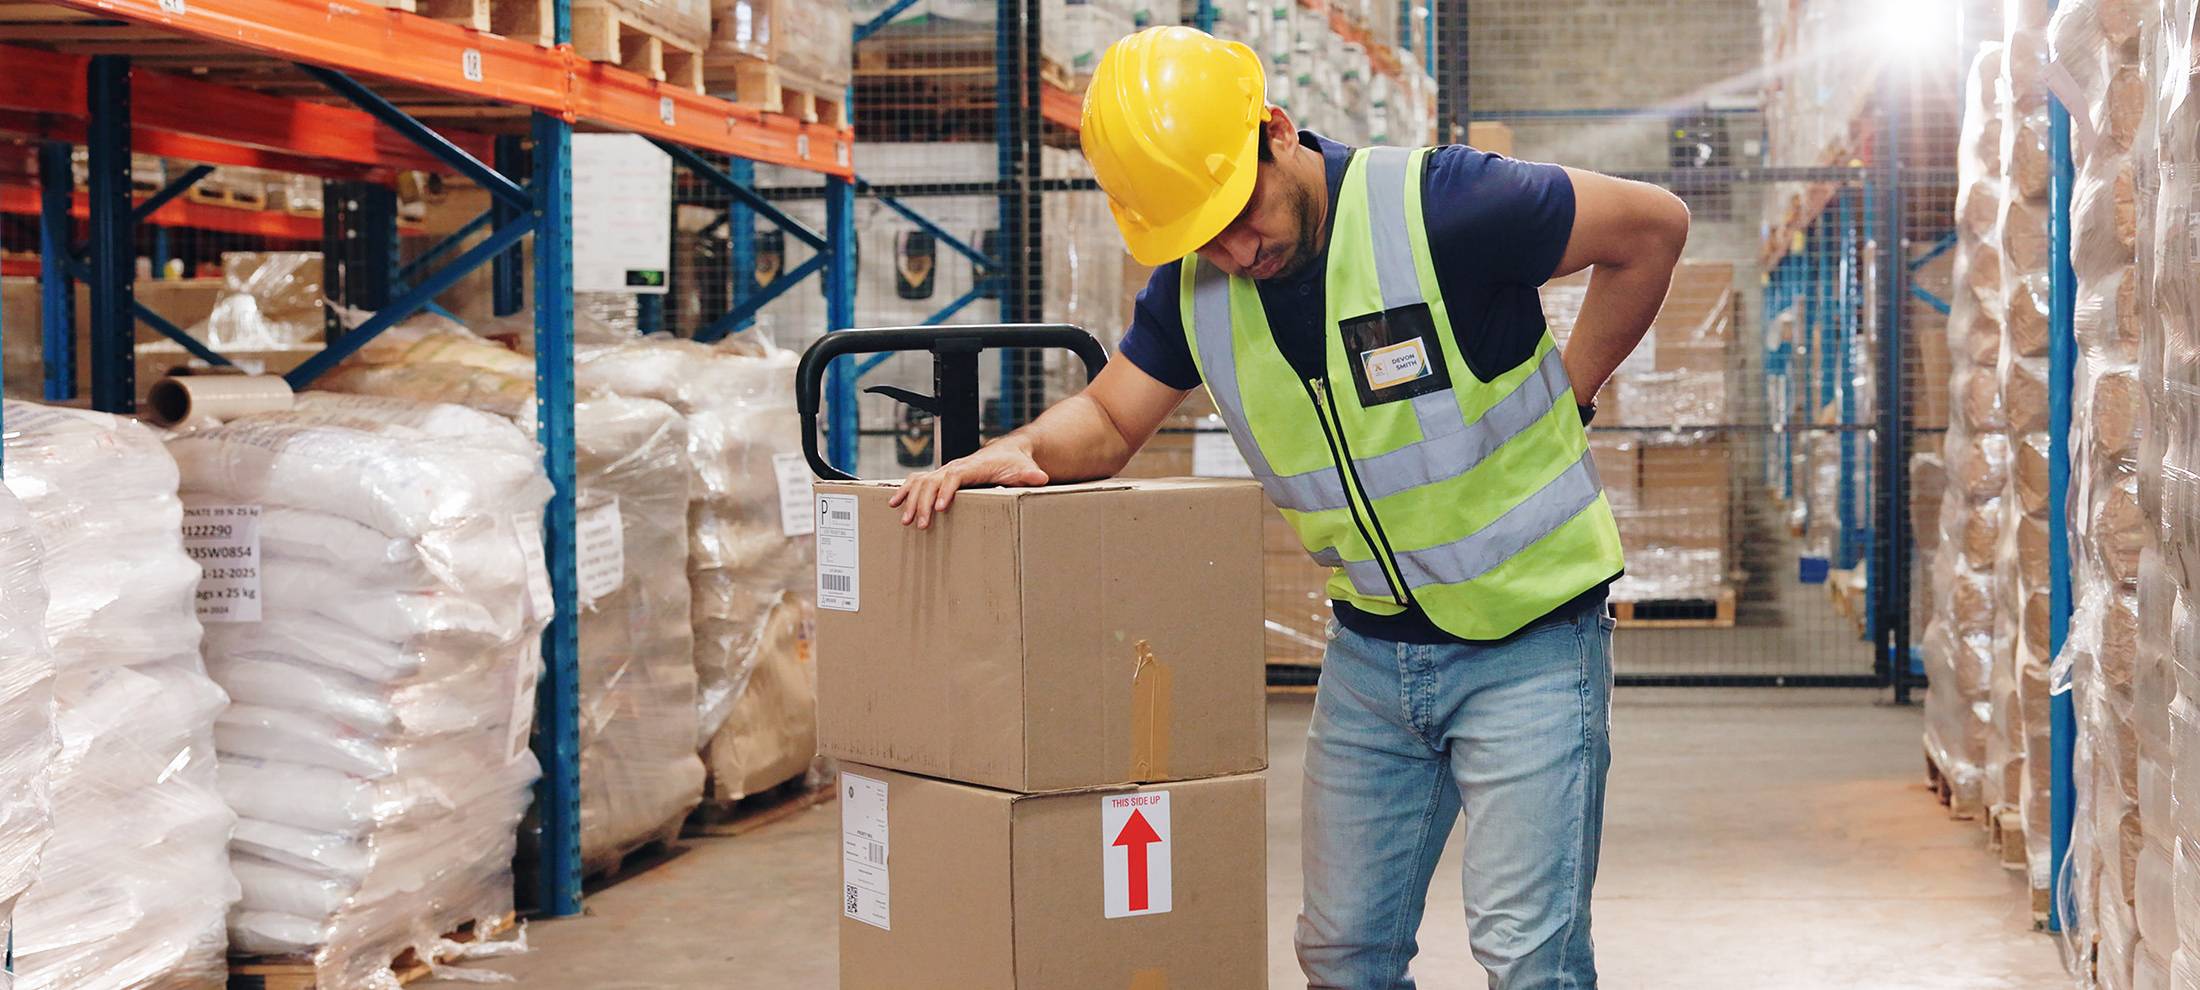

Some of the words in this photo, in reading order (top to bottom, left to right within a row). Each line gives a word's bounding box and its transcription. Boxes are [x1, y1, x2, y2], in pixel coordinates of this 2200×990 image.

[1392, 354, 1414, 364] DEVON
[1396, 361, 1416, 370] SMITH
[822, 500, 828, 525] P
[226, 587, 240, 599] 25
[243, 586, 256, 600] kg
[1112, 798, 1129, 808] THIS
[1131, 796, 1148, 806] SIDE
[1150, 796, 1160, 804] UP
